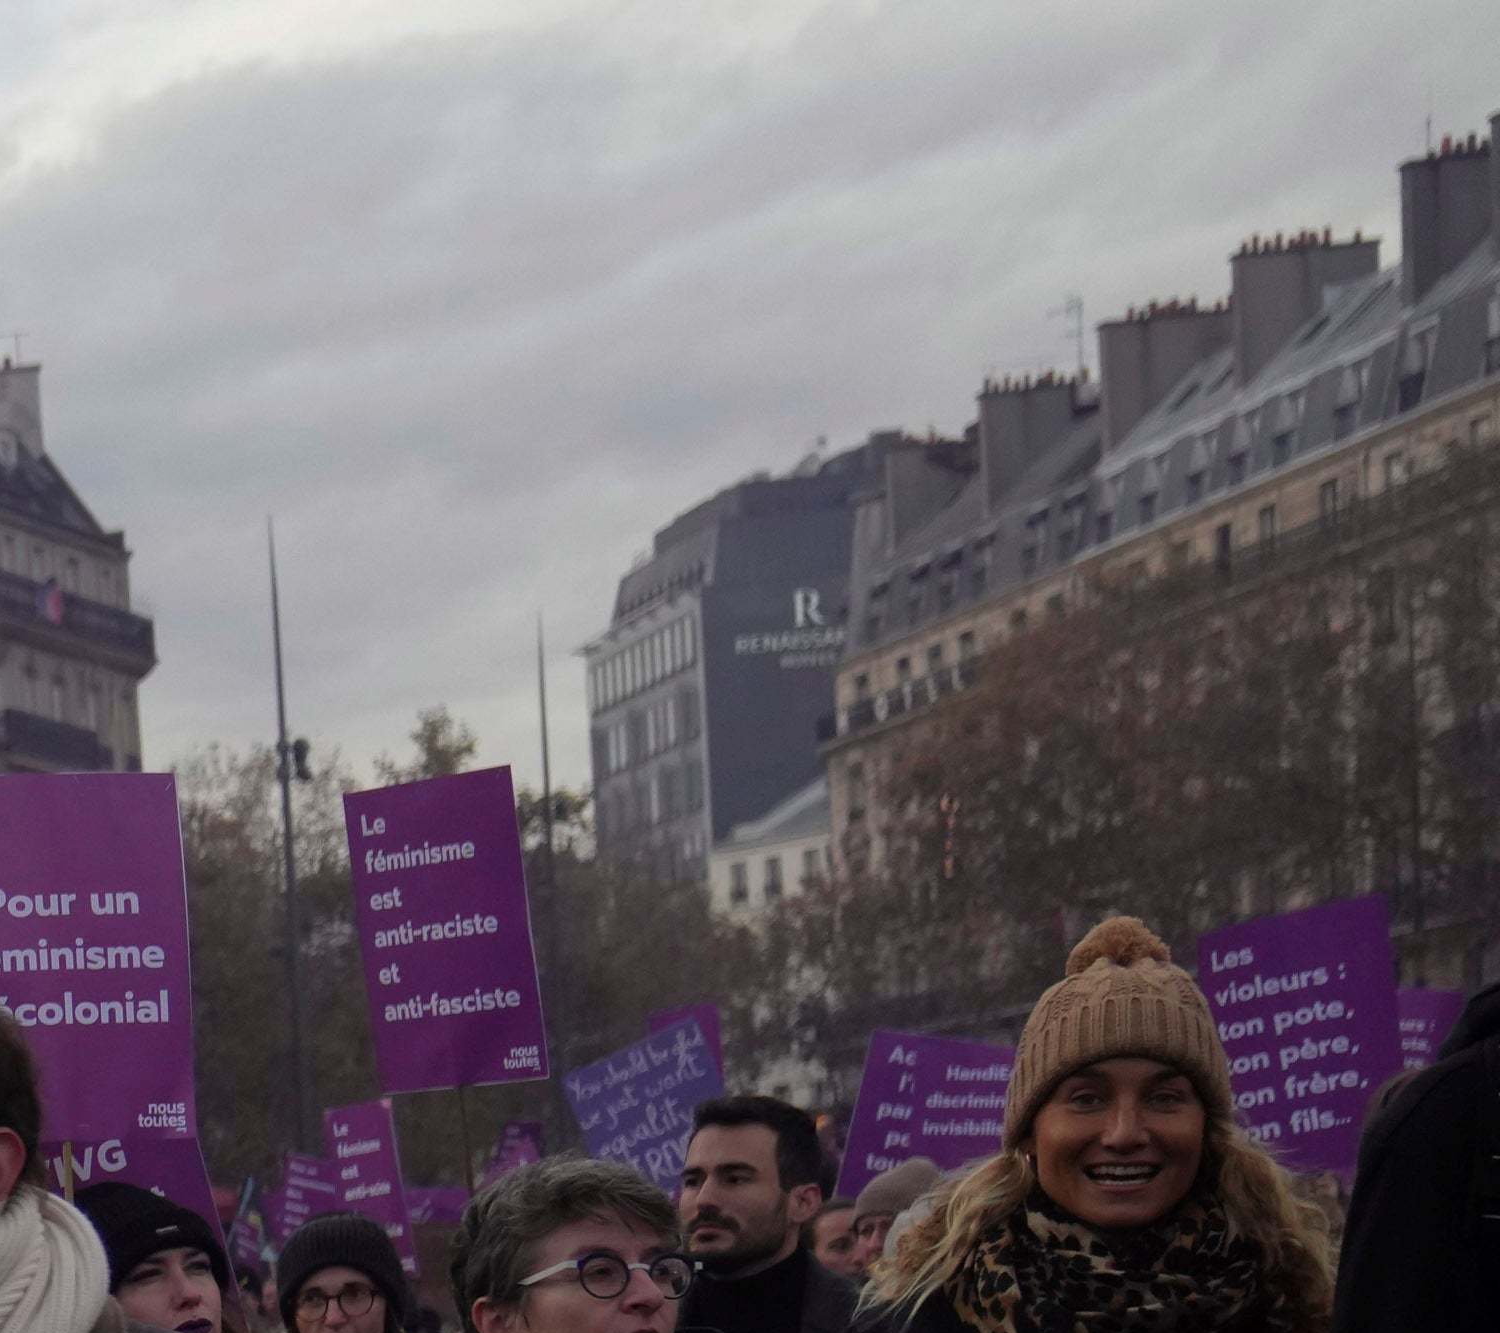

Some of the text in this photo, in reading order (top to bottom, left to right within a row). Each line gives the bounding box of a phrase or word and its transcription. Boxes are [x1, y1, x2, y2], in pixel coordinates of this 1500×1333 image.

[360, 814, 386, 836] Le
[365, 840, 475, 873] féminisme
[90, 890, 140, 915] un
[370, 886, 402, 911] est
[374, 913, 498, 948] anti-raciste
[1211, 947, 1254, 973] Les
[379, 963, 400, 985] et
[1214, 966, 1329, 1007] violeurs
[384, 988, 521, 1022] anti-fasciste
[1218, 1000, 1355, 1042] ton pote,
[503, 1056, 540, 1070] toutes
[510, 1046, 539, 1057] nous
[1279, 1035, 1360, 1071] père,
[1284, 1070, 1369, 1099] frère,
[138, 1113, 187, 1128] toutes
[148, 1102, 186, 1115] nous
